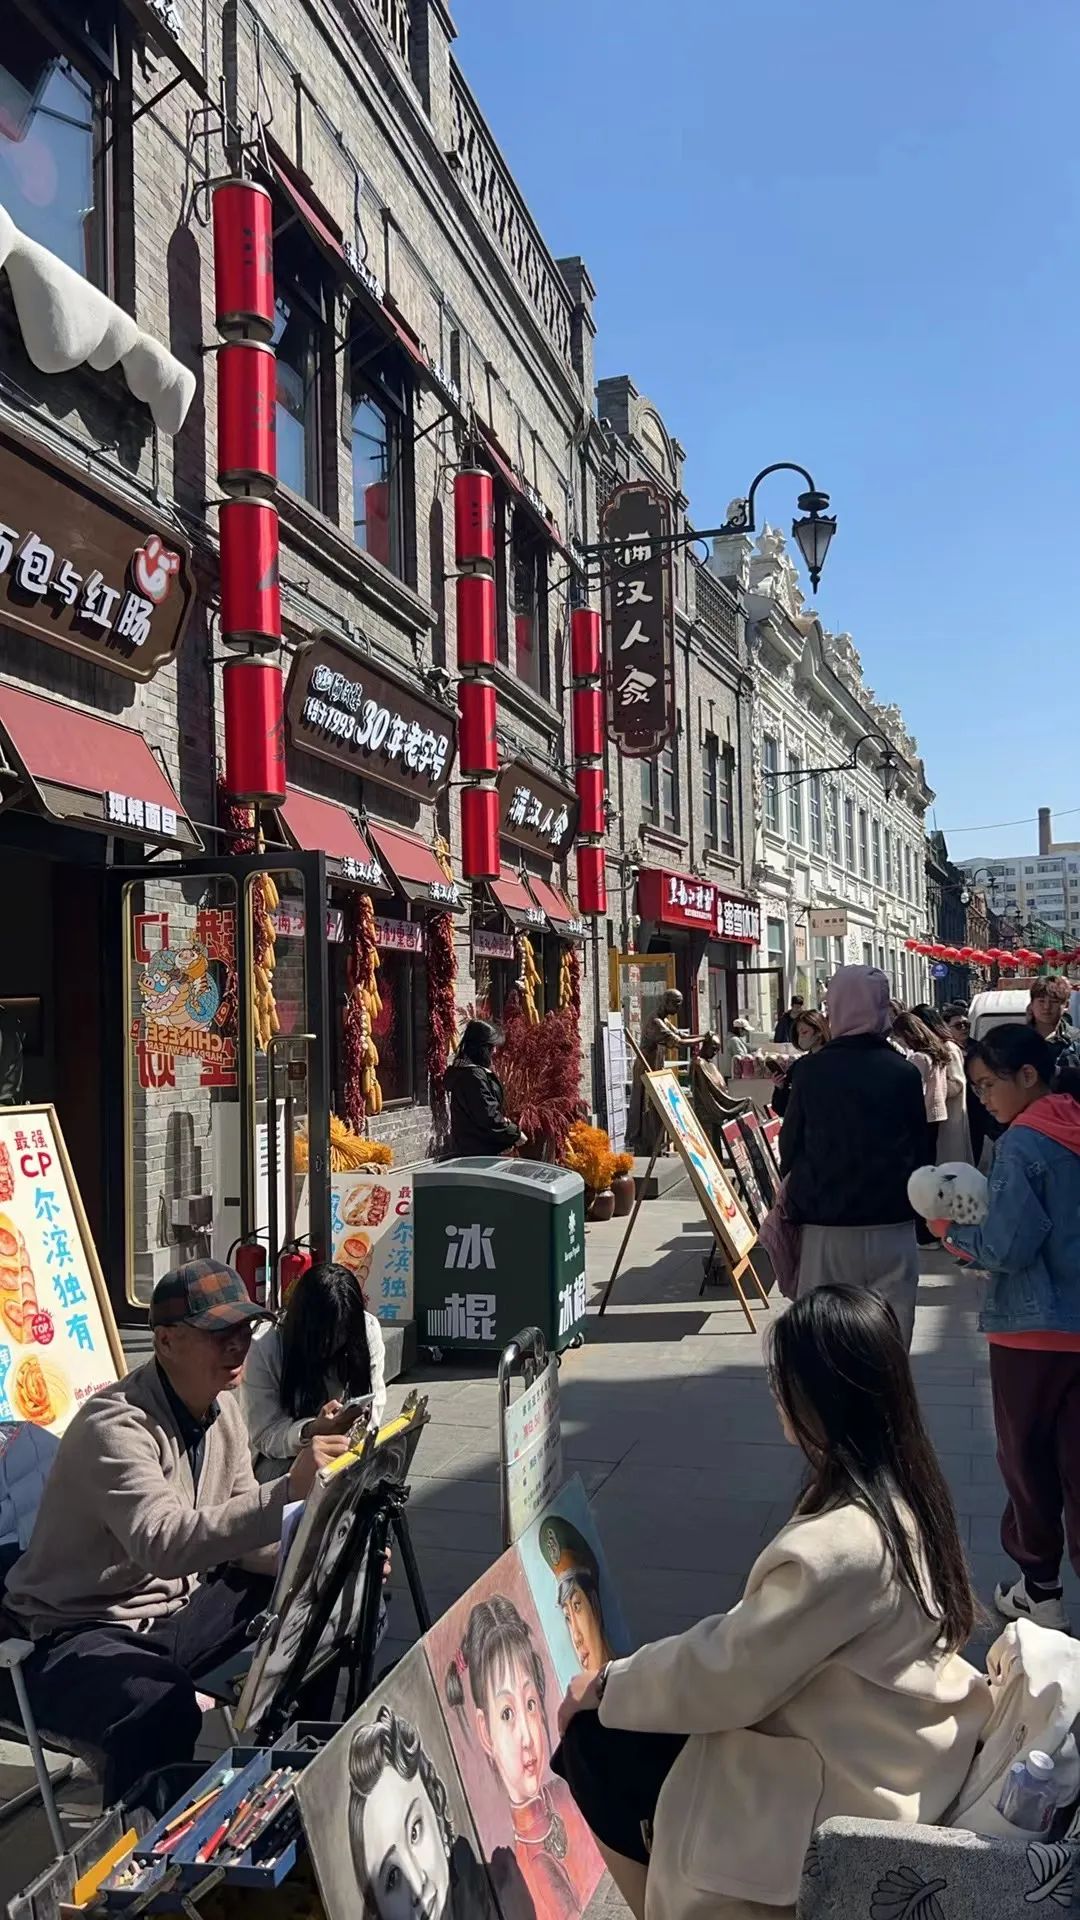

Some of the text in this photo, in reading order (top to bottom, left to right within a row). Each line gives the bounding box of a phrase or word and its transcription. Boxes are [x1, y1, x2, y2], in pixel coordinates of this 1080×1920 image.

[355, 699, 449, 781] 30年老字号
[108, 790, 177, 835] 现烤面包
[508, 786, 569, 845] 满汉人家
[14, 1130, 48, 1151] 最强
[20, 1152, 52, 1178] CP
[35, 1187, 95, 1351] 尔滨独有
[559, 1271, 585, 1336] 冰棍
